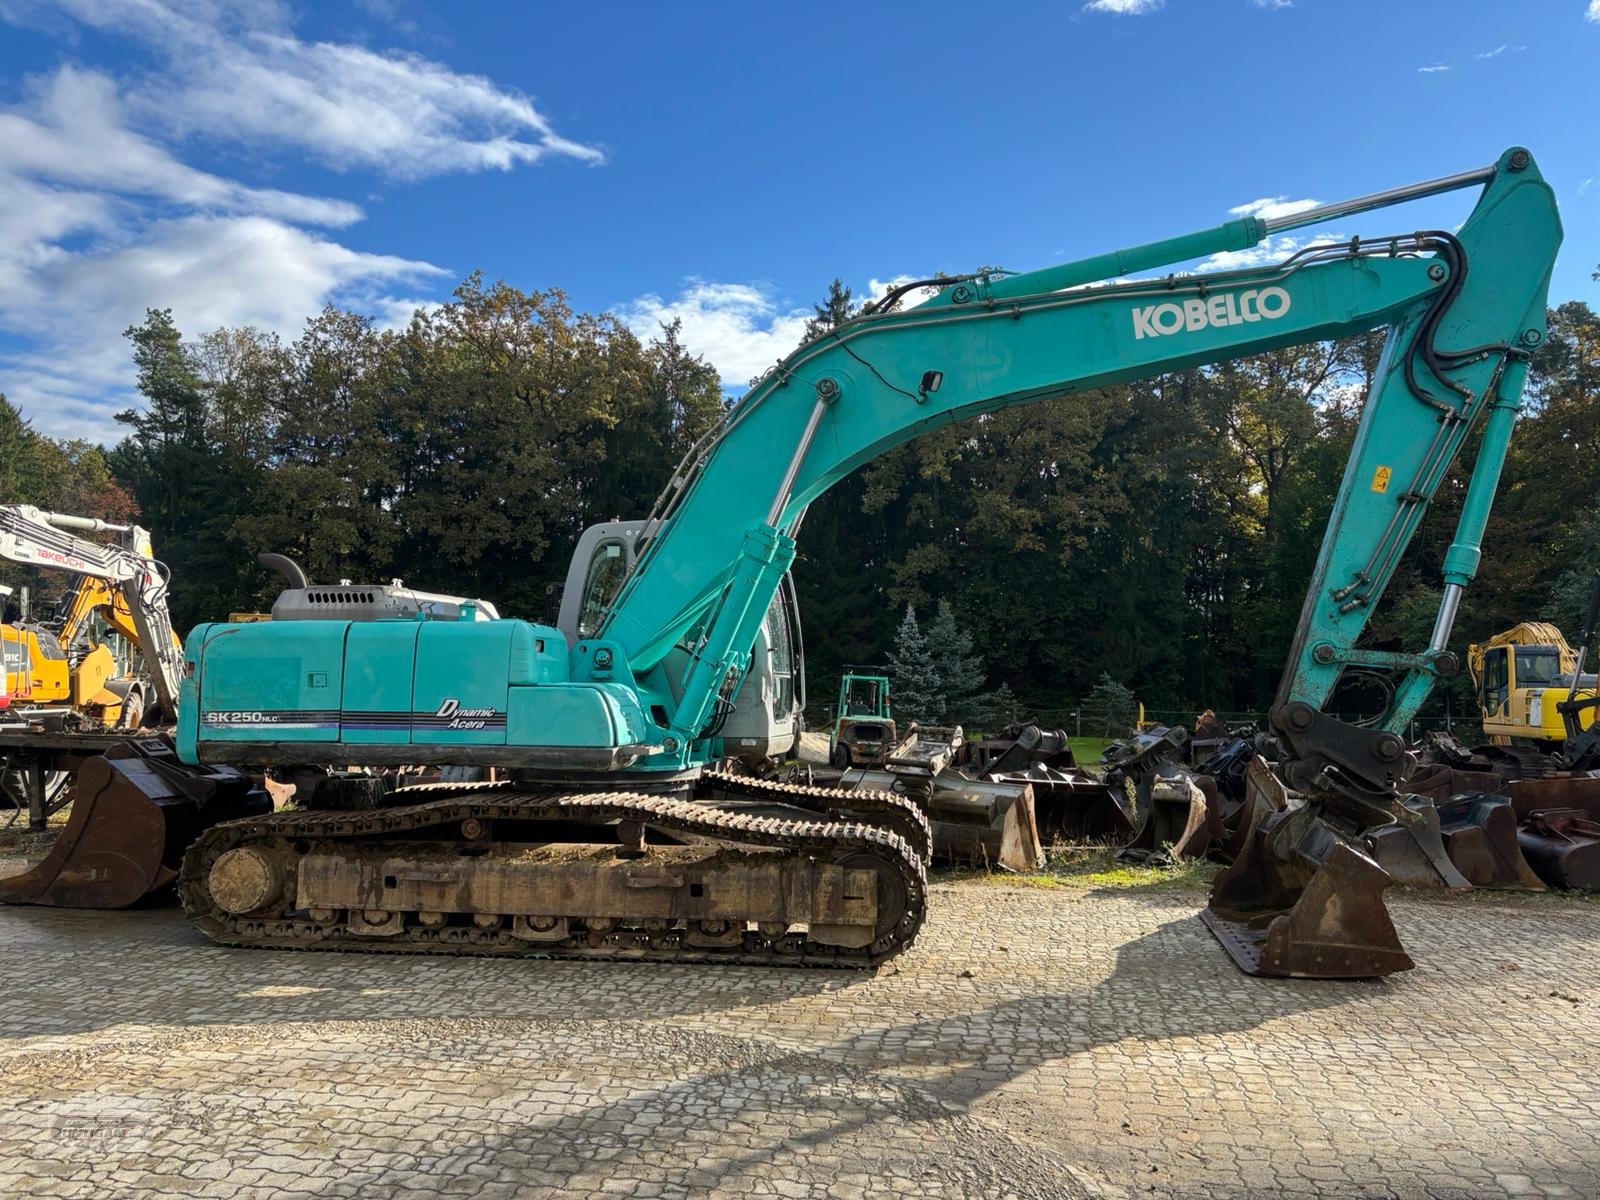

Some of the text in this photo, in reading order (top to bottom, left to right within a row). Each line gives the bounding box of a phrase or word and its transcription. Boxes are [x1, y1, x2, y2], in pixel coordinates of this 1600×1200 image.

[1132, 286, 1291, 340] KOBELCO
[436, 699, 496, 719] Dynamic
[447, 718, 486, 729] Acera
